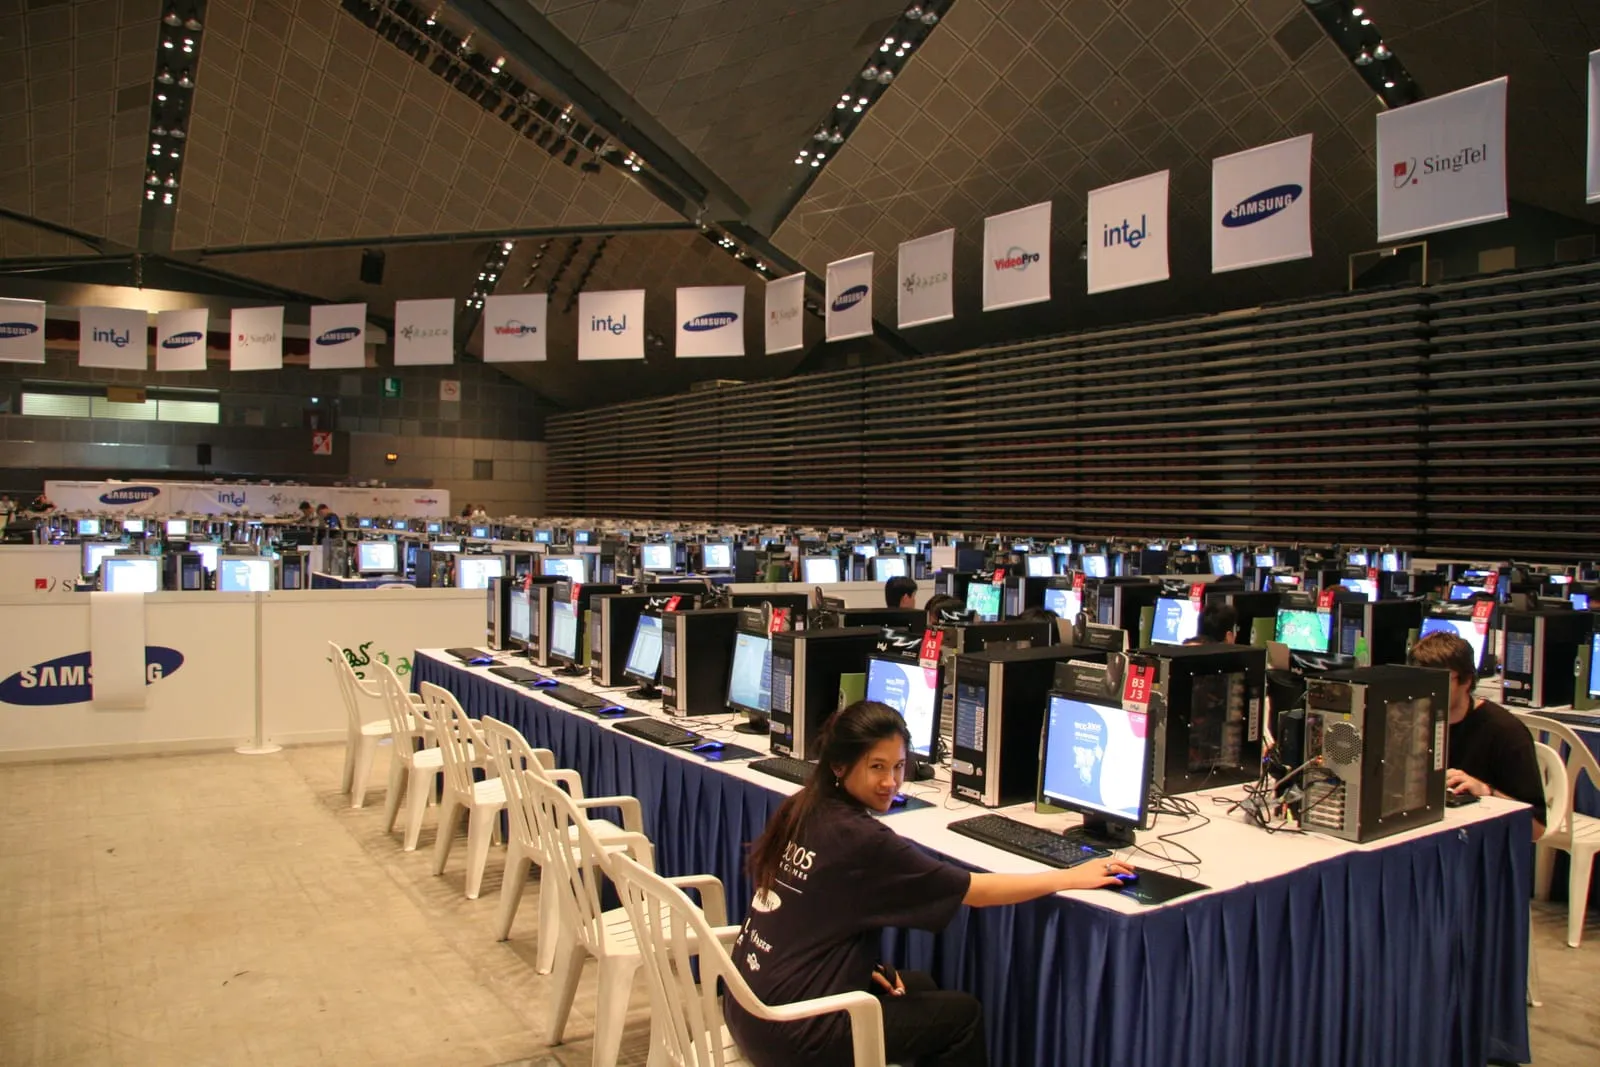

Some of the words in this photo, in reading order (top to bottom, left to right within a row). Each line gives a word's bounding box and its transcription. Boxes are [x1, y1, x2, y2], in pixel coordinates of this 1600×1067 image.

[1423, 144, 1487, 174] SingTel
[1231, 193, 1292, 218] SAMSUNG
[1103, 214, 1146, 248] intel
[994, 253, 1040, 271] VideoPro
[591, 314, 626, 335] intel
[689, 316, 732, 327] SAMSUNG
[93, 327, 129, 347] intel
[107, 490, 154, 500] SAMSUNG
[218, 490, 246, 507] intel
[20, 662, 163, 689] SAMG
[1131, 677, 1145, 688] B3
